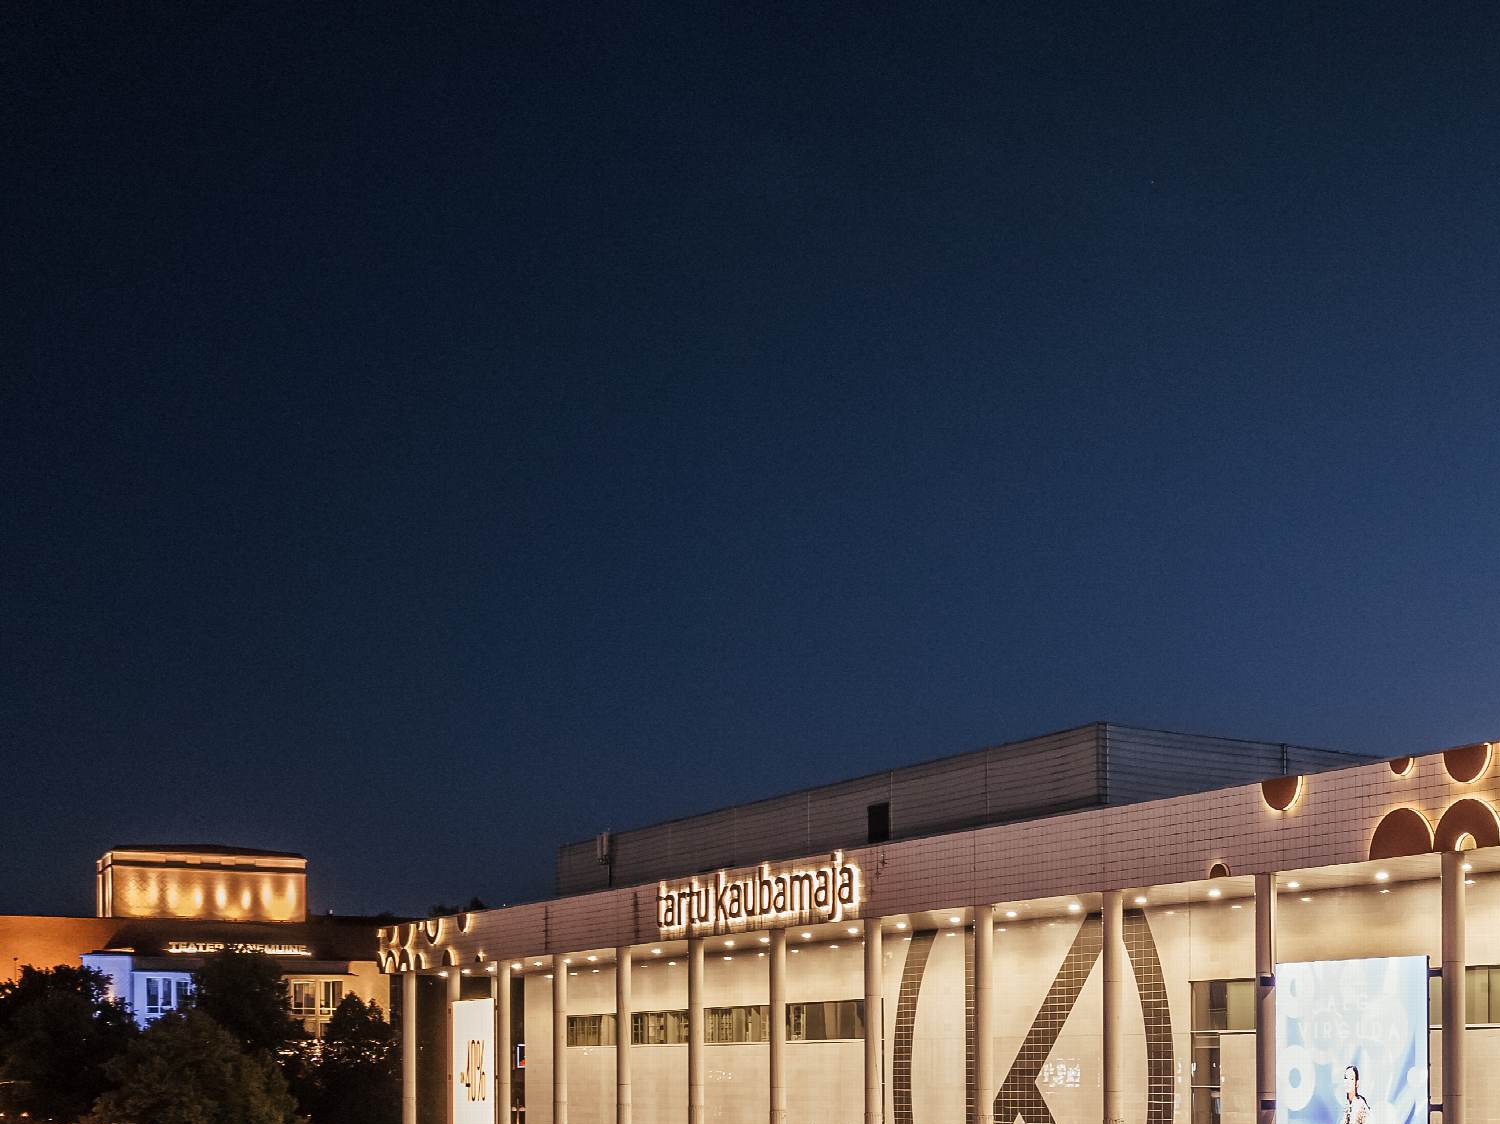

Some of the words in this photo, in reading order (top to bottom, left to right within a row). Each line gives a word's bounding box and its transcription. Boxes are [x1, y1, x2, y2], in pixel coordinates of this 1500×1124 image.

[656, 884, 711, 928] tartu
[715, 852, 855, 921] kaubamaja
[168, 941, 225, 954] TEATER
